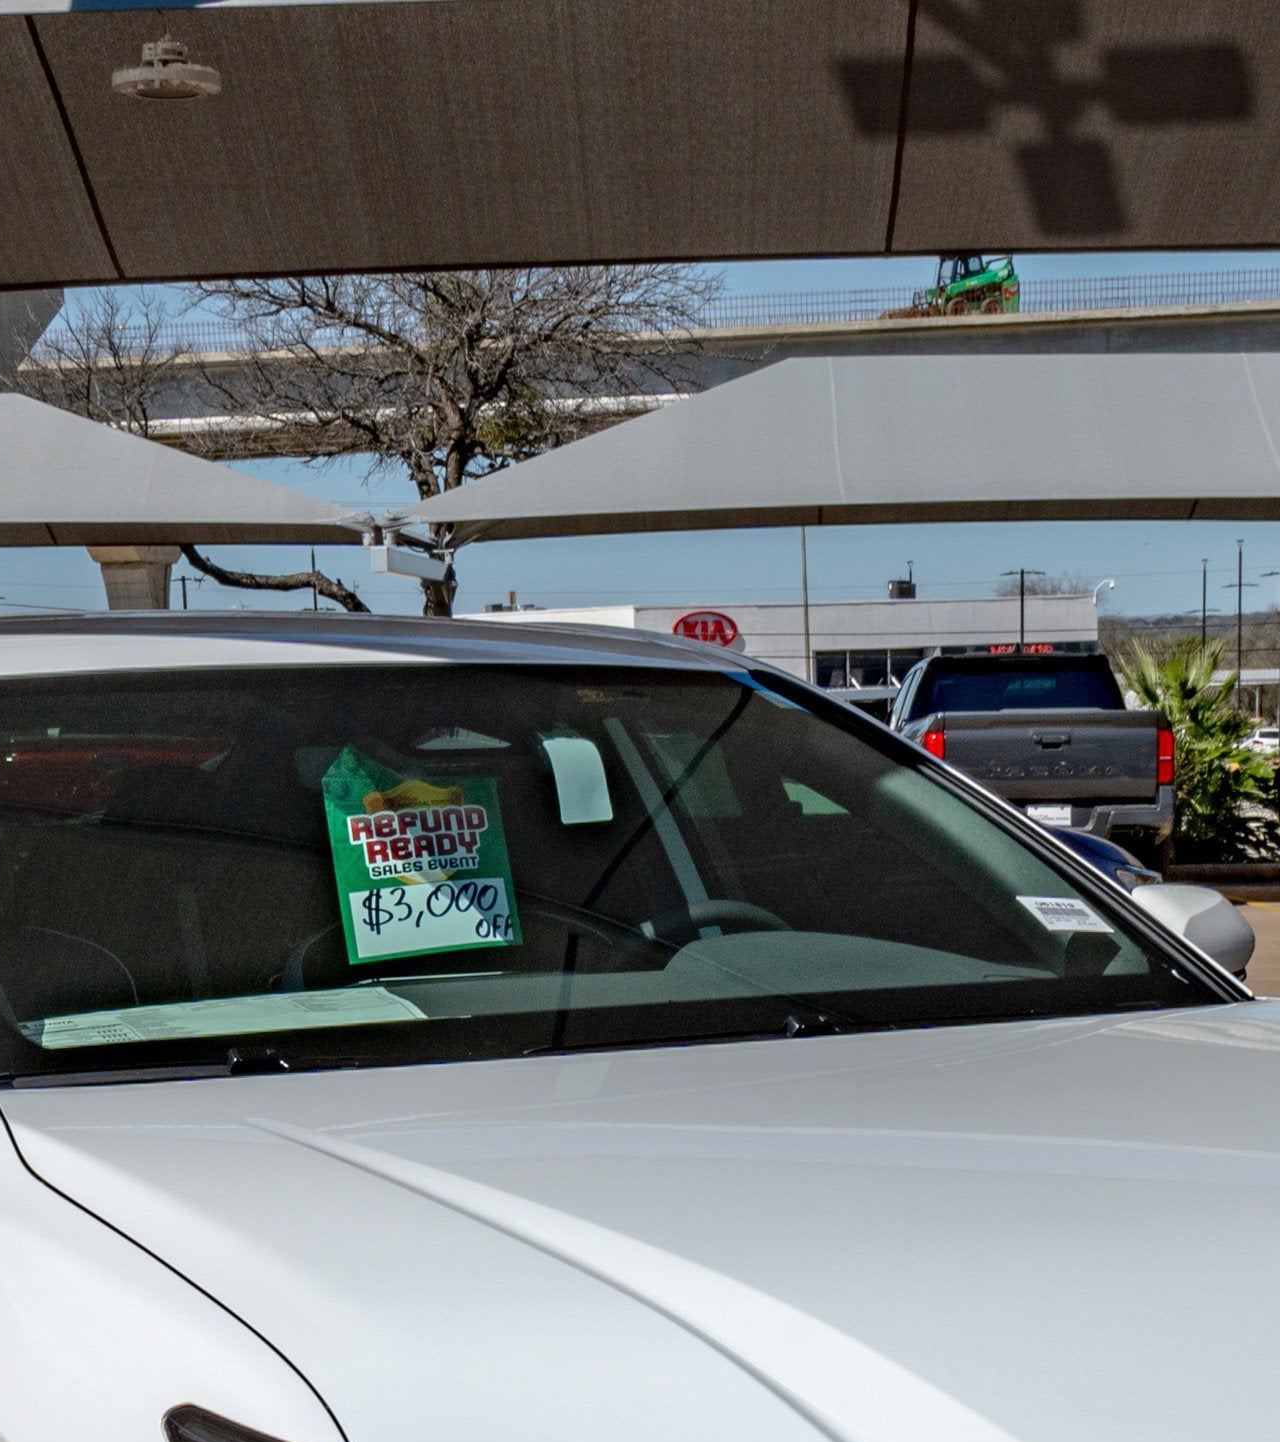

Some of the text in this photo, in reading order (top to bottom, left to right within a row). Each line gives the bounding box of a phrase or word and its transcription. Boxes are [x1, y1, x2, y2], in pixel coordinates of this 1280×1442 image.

[682, 620, 730, 647] KIA
[350, 806, 486, 842] REFUND
[366, 832, 478, 864] READY
[372, 857, 477, 877] SALES EVENT
[362, 882, 498, 936] $3,000
